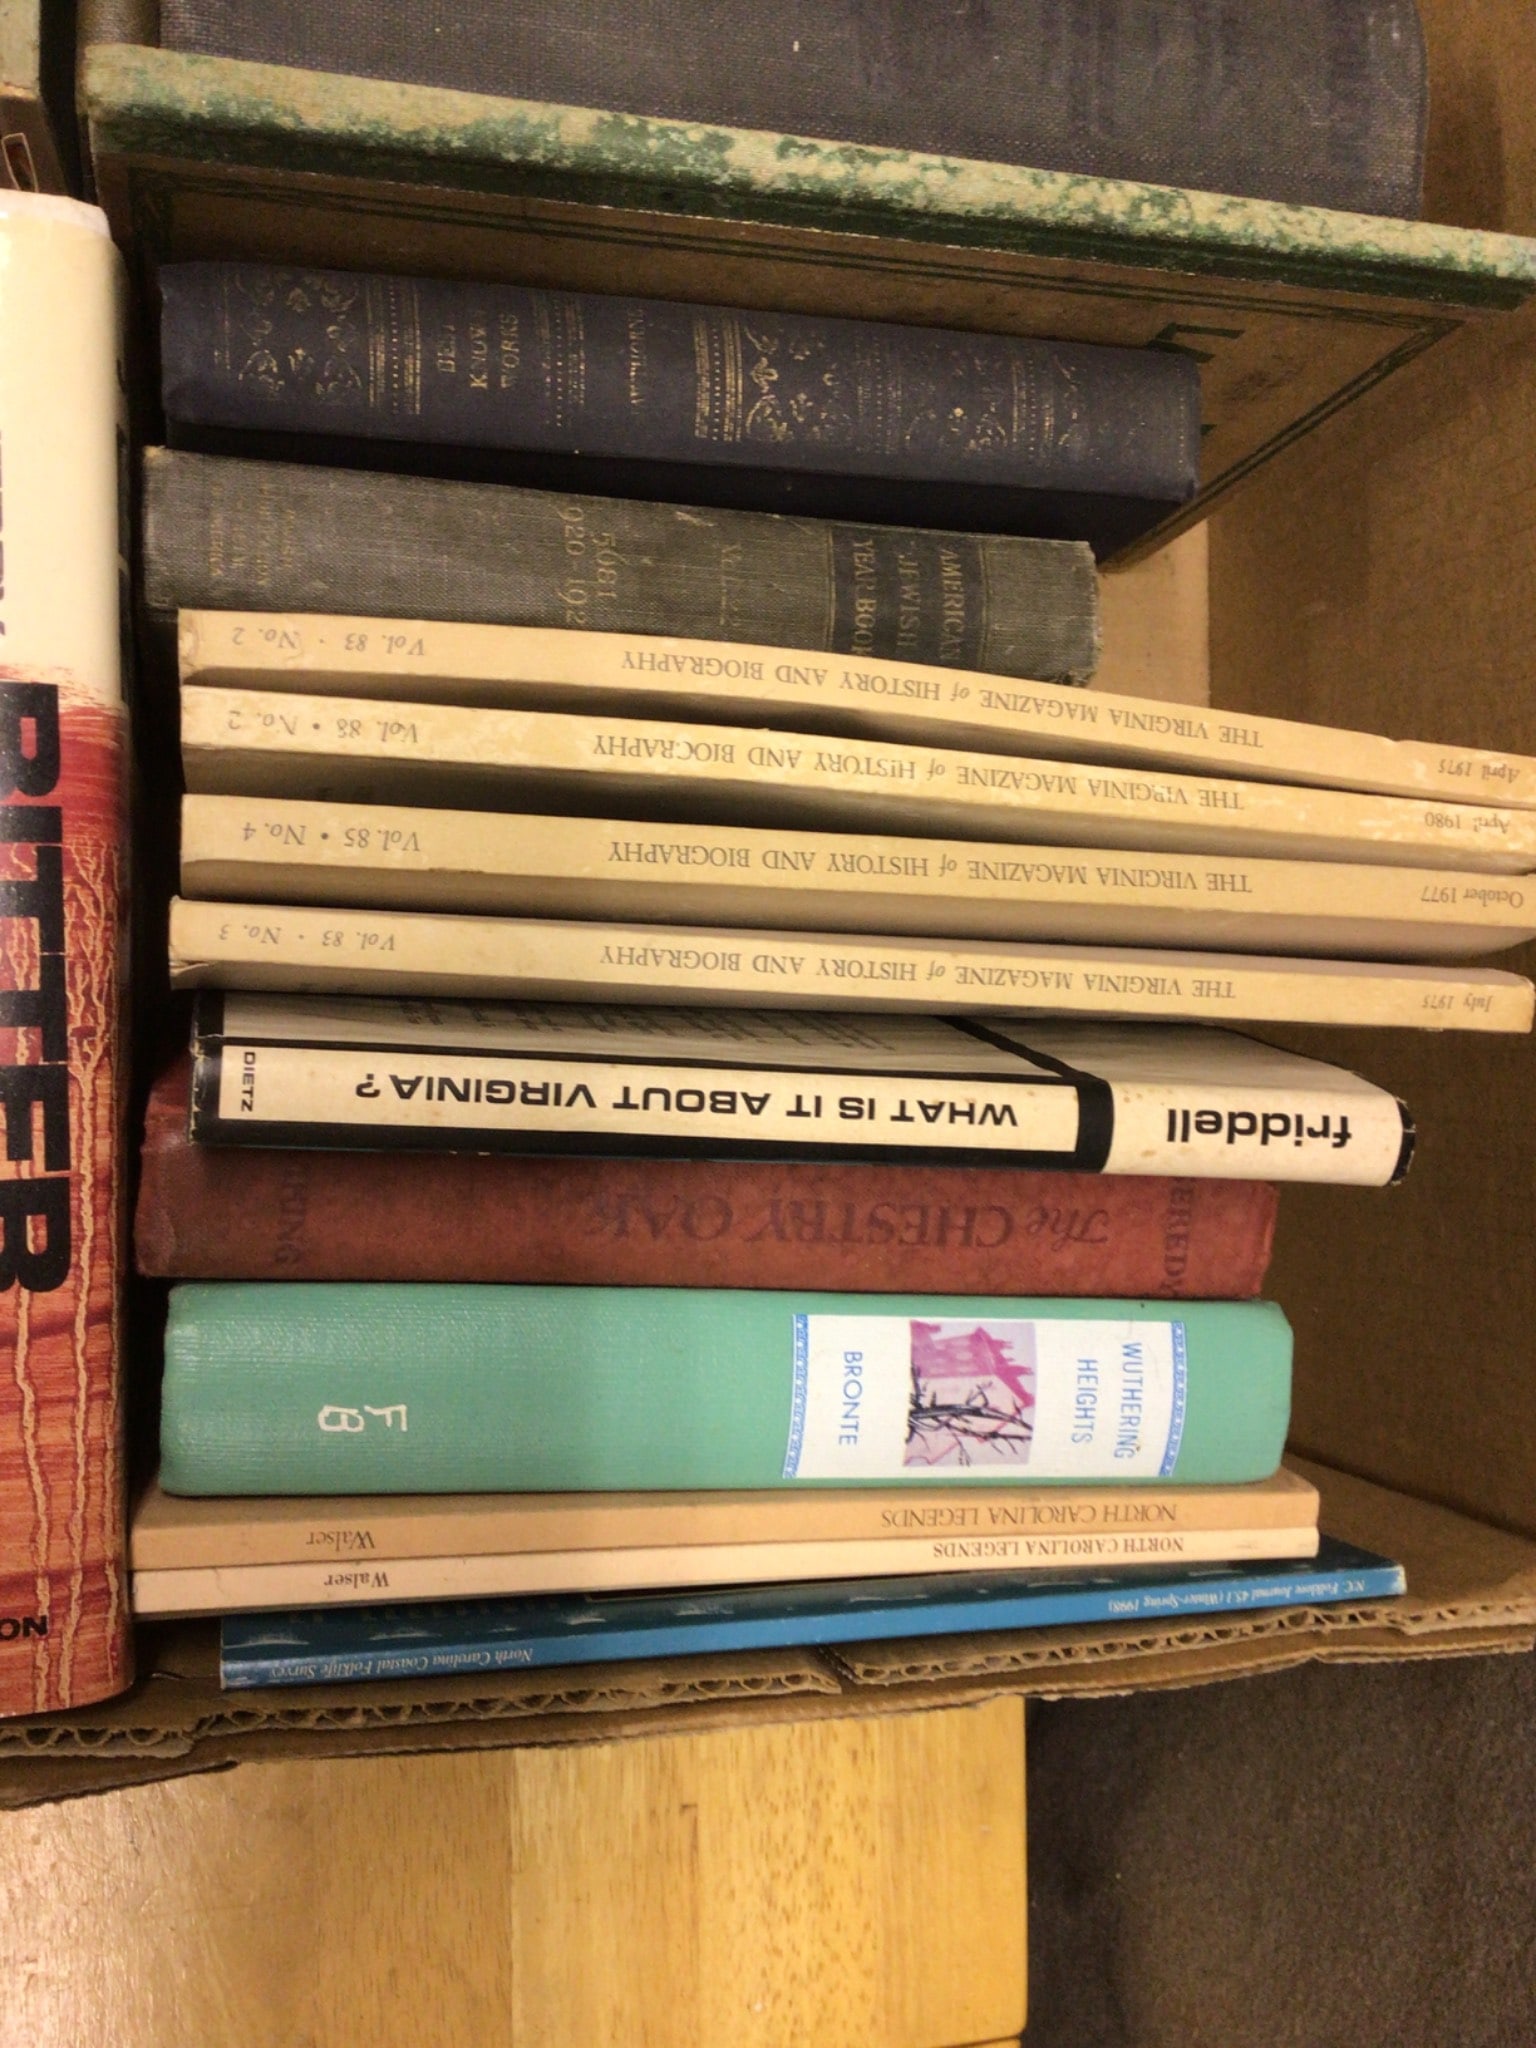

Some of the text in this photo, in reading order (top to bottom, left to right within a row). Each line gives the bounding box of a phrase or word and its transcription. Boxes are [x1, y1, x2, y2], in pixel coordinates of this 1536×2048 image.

[897, 554, 921, 646] JEWISH
[940, 549, 965, 661] AMERICAN
[231, 626, 425, 656] Vol. 83 No. 2
[620, 650, 1264, 748] THE VIRGINIA MAGAZINE of HISTORY AND BIOGRAPHY
[227, 709, 242, 730] 2
[375, 720, 418, 743] Vol.
[592, 734, 1244, 810] THE VIRGINIA MAGAZINE of HISTORY AND BIOGRAPHY
[1437, 758, 1521, 784] April 1975
[1423, 810, 1462, 830] 1980
[242, 821, 421, 852] Vol. 85 No. 4
[607, 840, 1253, 893] THE VIRGINIA MAGAZINE of HISTORY AND BIOGRAPHY
[1419, 885, 1524, 909] October 1977
[217, 923, 395, 952] Vol. 83 No. 3
[599, 944, 1236, 999] THE VIRGINIA MAGAZINE of HISTORY AND BIOGRAPHY
[1420, 991, 1493, 1013] July 1975
[239, 1050, 256, 1113] DIETZ
[354, 1072, 1018, 1127] WHAT IS IT ABOUT VIRGINIA?
[1167, 1107, 1352, 1149] friddell
[582, 1192, 1109, 1250] The CHESTRY OAK
[837, 1350, 862, 1447] BRONTE
[1070, 1358, 1098, 1445] HEIGHTS
[1113, 1341, 1142, 1460] WUTHERING
[880, 1503, 1176, 1527] NORTH CAROLINA LEGENDS
[305, 1530, 376, 1552] Walser
[932, 1536, 1183, 1557] NORTH CAROLINA LEGENDS
[323, 1571, 389, 1589] Walser
[1250, 1585, 1292, 1601] Journal
[269, 1647, 533, 1681] North Carolina Coastal Folklife Survey
